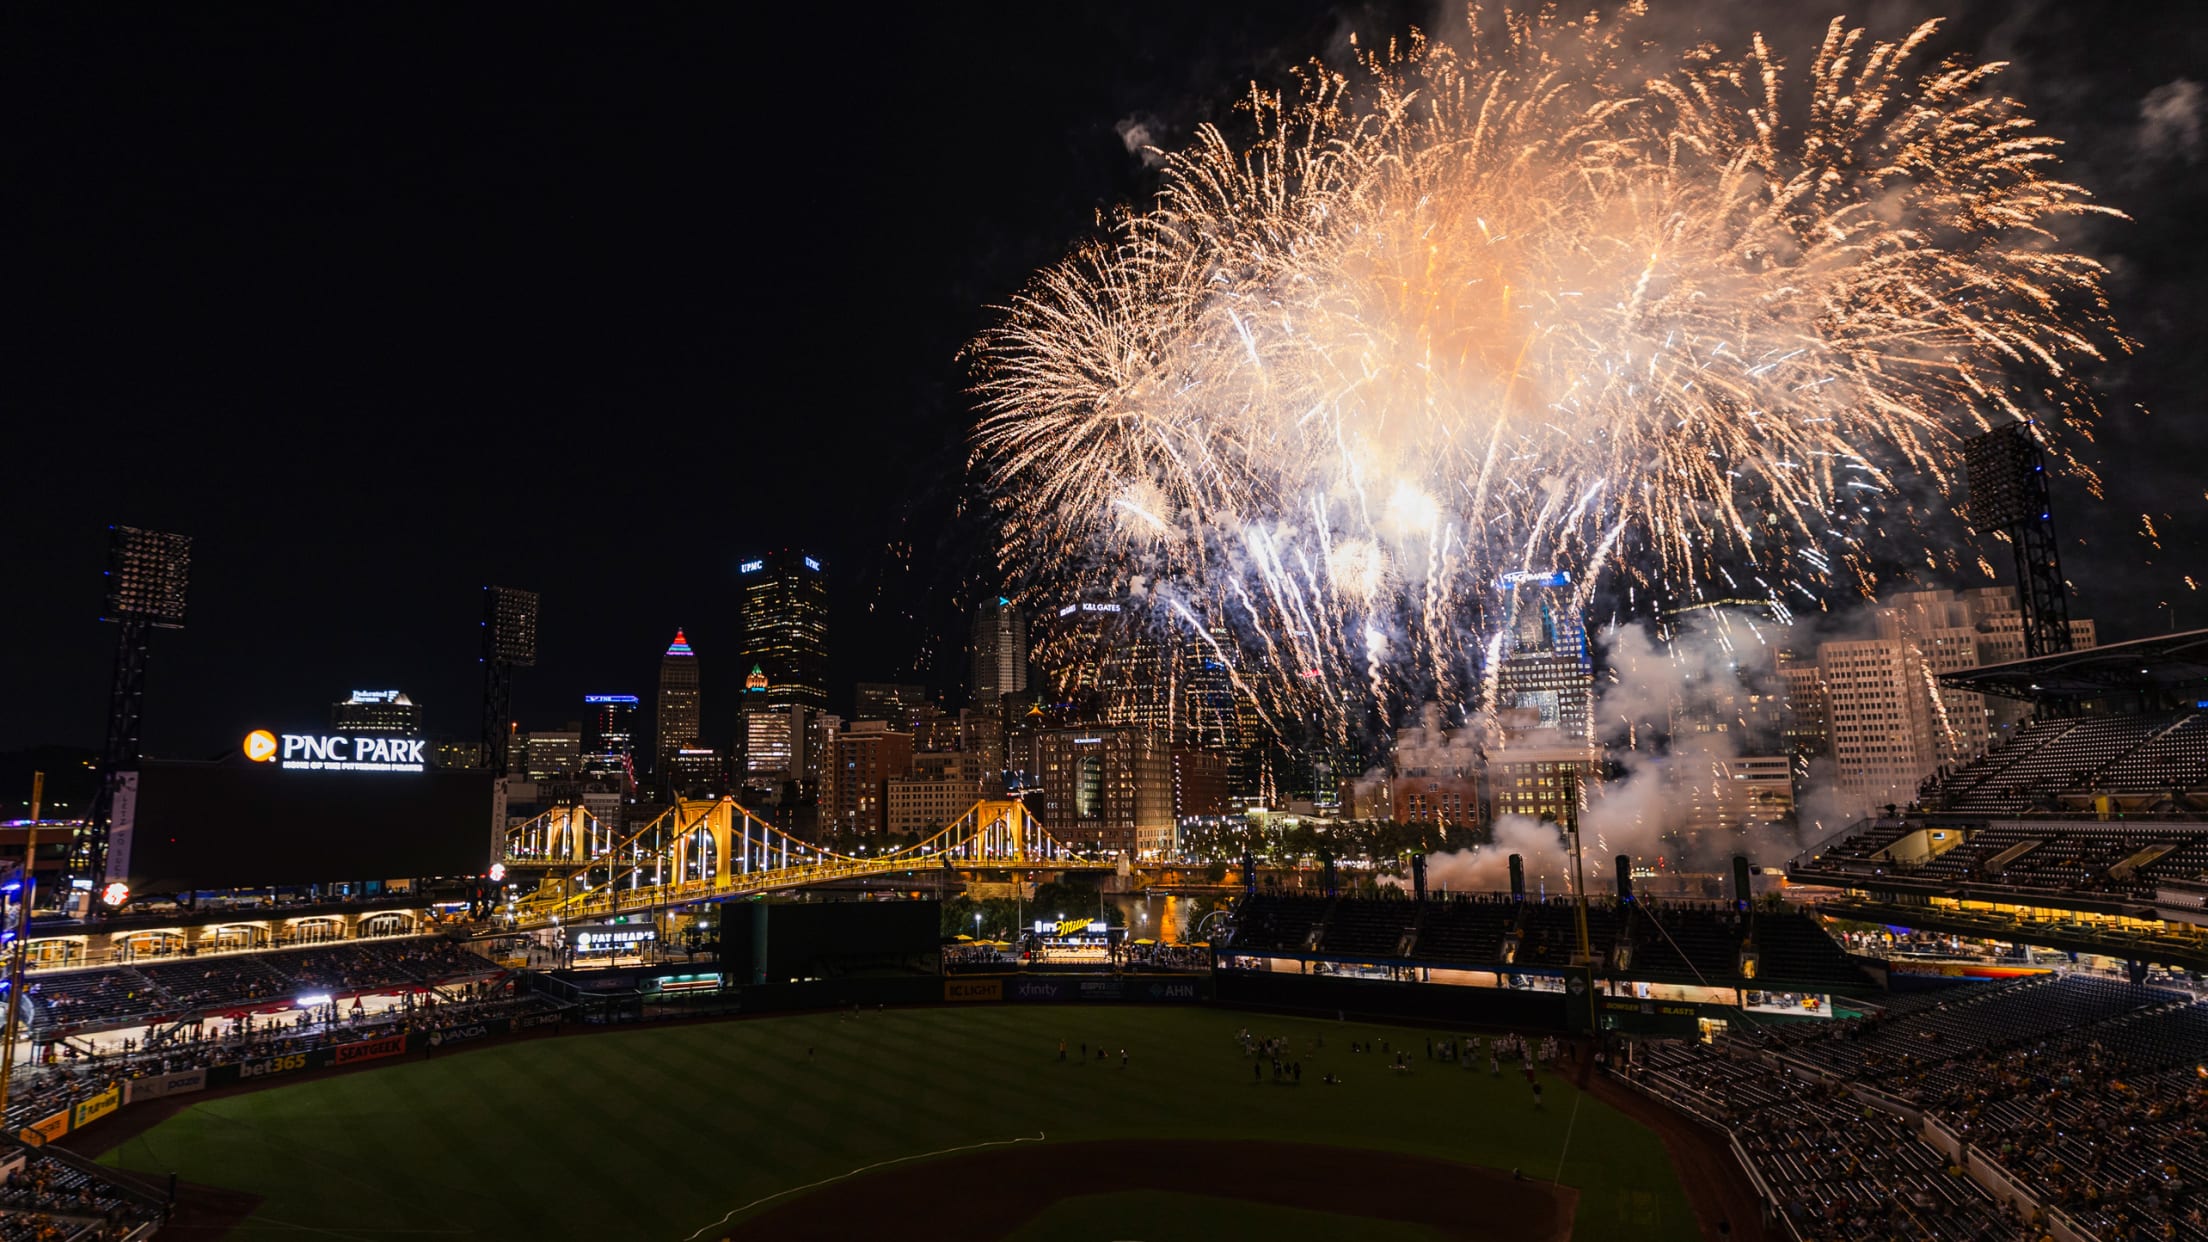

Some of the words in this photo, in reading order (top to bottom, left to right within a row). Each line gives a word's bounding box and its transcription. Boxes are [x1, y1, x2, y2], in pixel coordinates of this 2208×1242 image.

[741, 560, 763, 573] UPMC
[1097, 603, 1121, 612] GATES
[281, 735, 349, 761] PNC
[354, 737, 426, 763] PARK
[1056, 917, 1095, 937] Miller
[591, 933, 613, 944] FAT
[613, 931, 655, 942] HEAD'S
[964, 985, 998, 996] LIGHT
[1018, 982, 1058, 997] xfinity
[1165, 984, 1194, 997] AHN
[339, 1040, 402, 1061] SEATGEEK
[240, 1053, 306, 1078] bet365
